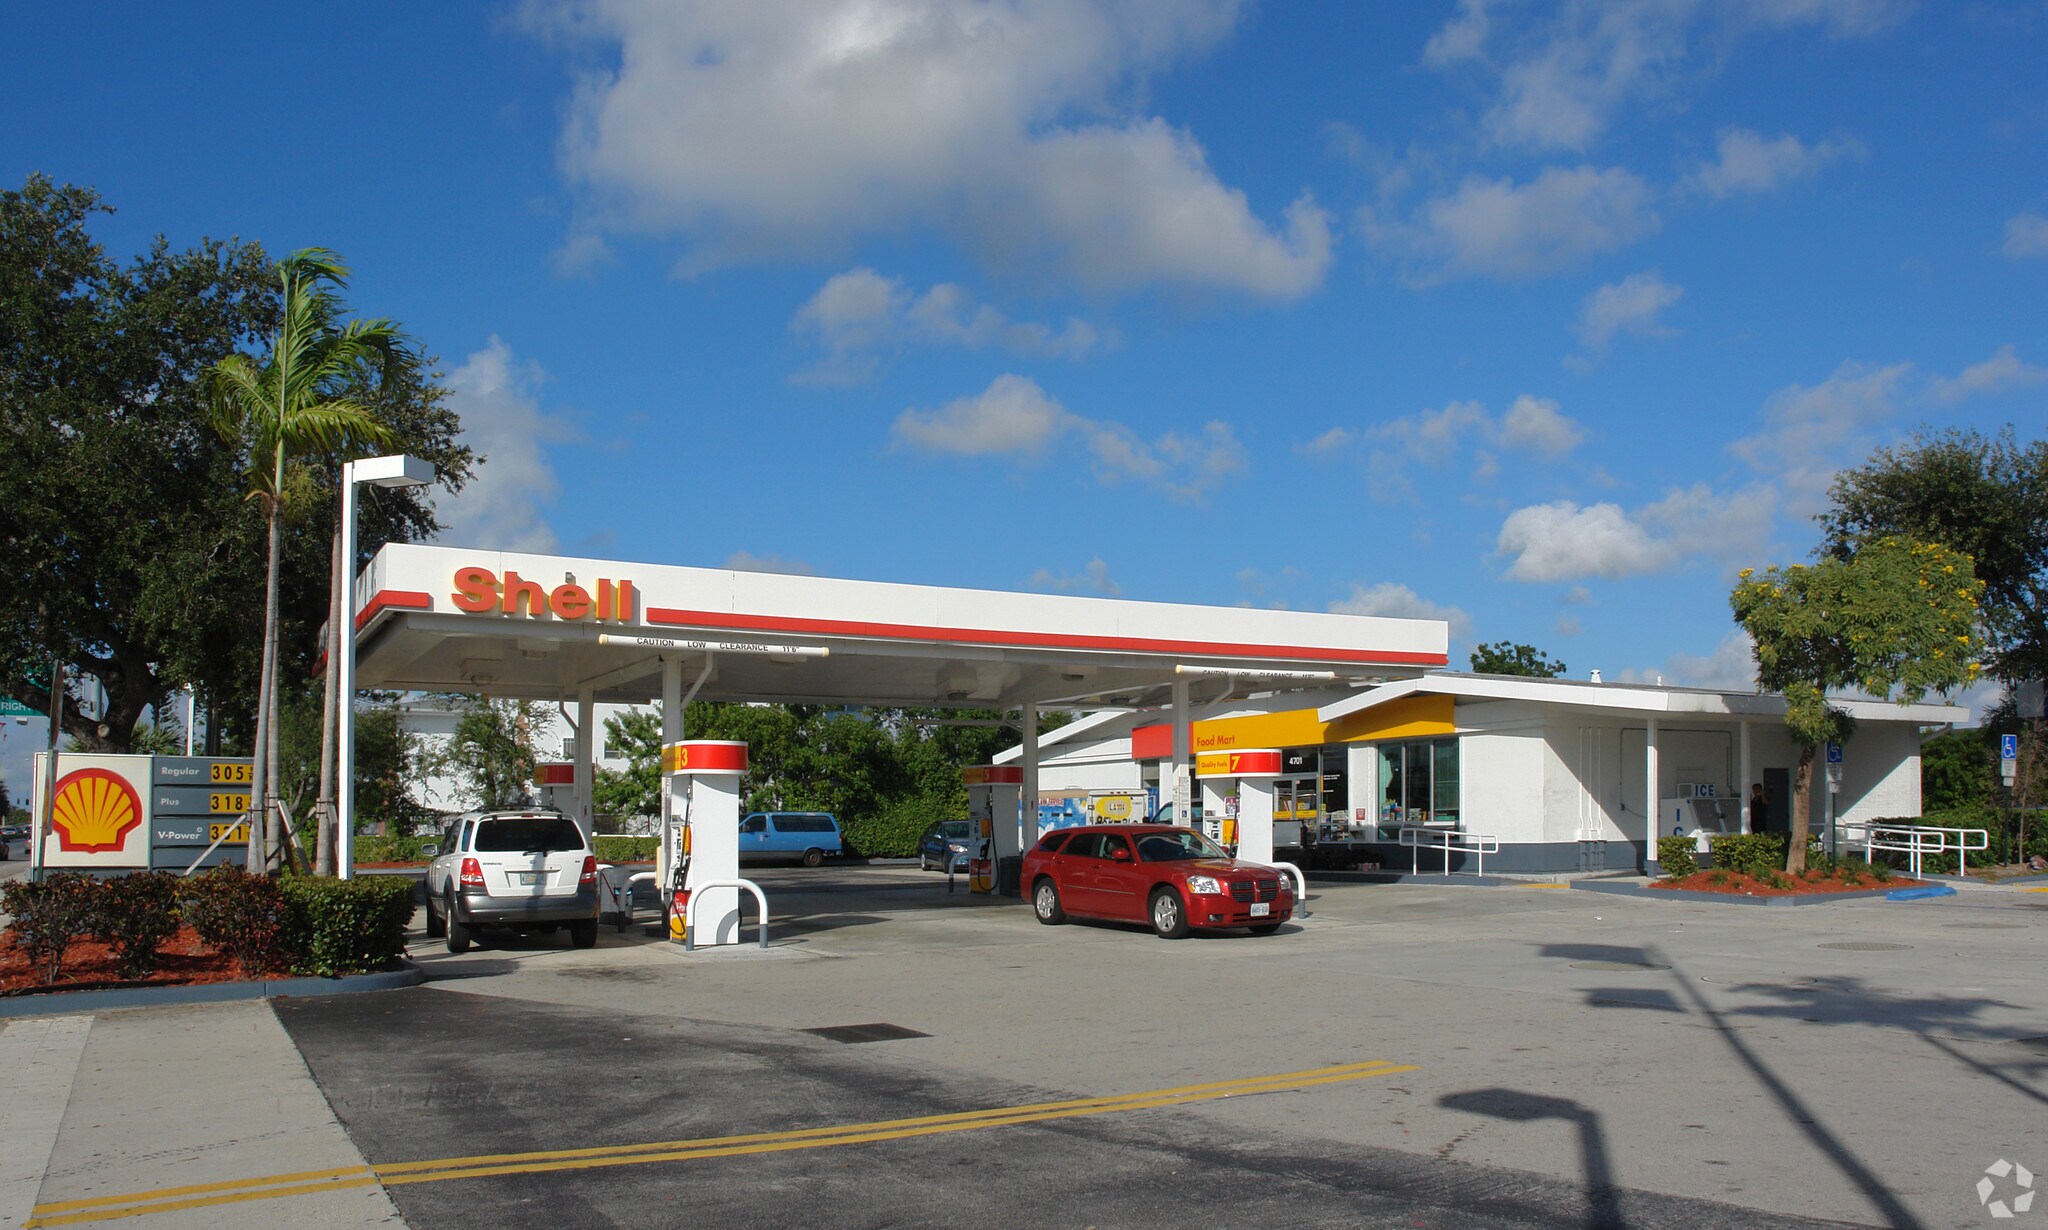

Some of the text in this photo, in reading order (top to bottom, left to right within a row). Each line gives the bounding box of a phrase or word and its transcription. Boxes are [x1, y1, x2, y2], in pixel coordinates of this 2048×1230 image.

[451, 566, 633, 621] Shell
[636, 637, 675, 648] CAUTION
[687, 641, 707, 649] LOW
[719, 642, 769, 652] CLEARANCE
[1, 701, 31, 711] RIGH
[1196, 734, 1235, 747] Food Mart
[681, 747, 689, 767] 3
[1230, 755, 1241, 771] 7
[1288, 756, 1303, 765] 4701
[1201, 760, 1228, 769] Quality Fuels
[161, 766, 200, 777] Regular
[212, 765, 244, 780] 305
[983, 768, 990, 781] 5
[1695, 784, 1715, 797] ICE
[160, 797, 180, 806] Plus
[211, 795, 243, 811] 318
[158, 830, 200, 840] V-Power
